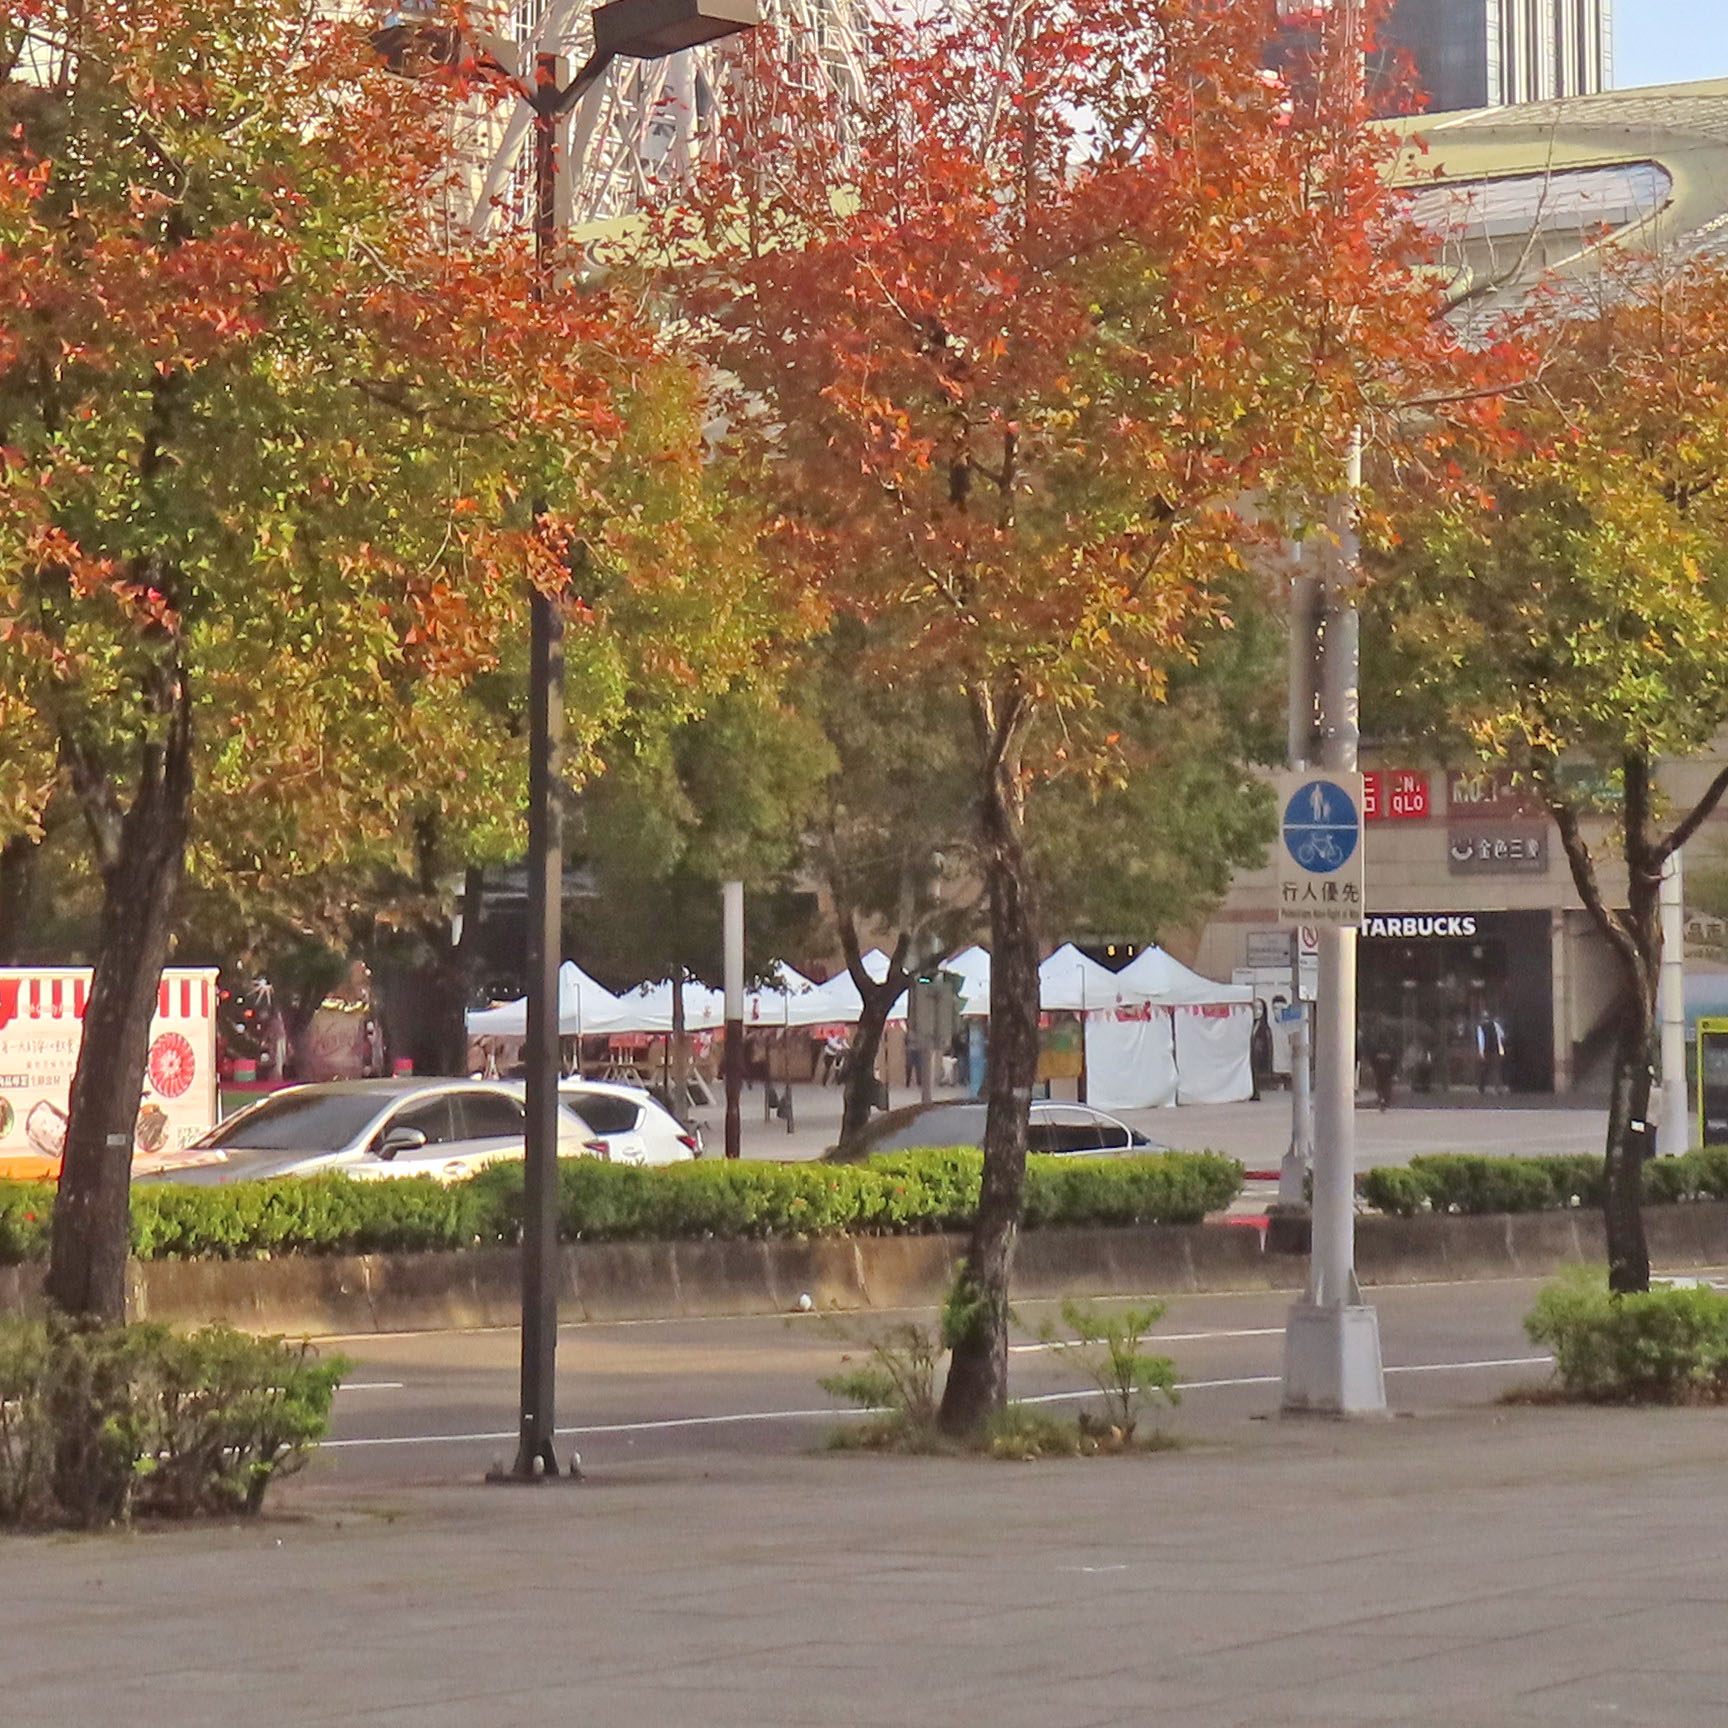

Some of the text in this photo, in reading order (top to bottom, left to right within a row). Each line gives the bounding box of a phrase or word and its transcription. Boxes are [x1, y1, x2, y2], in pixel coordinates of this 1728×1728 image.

[1452, 777, 1498, 803] MUI
[1282, 880, 1359, 904] 行人優先
[1361, 916, 1477, 938] TARBUCKS
